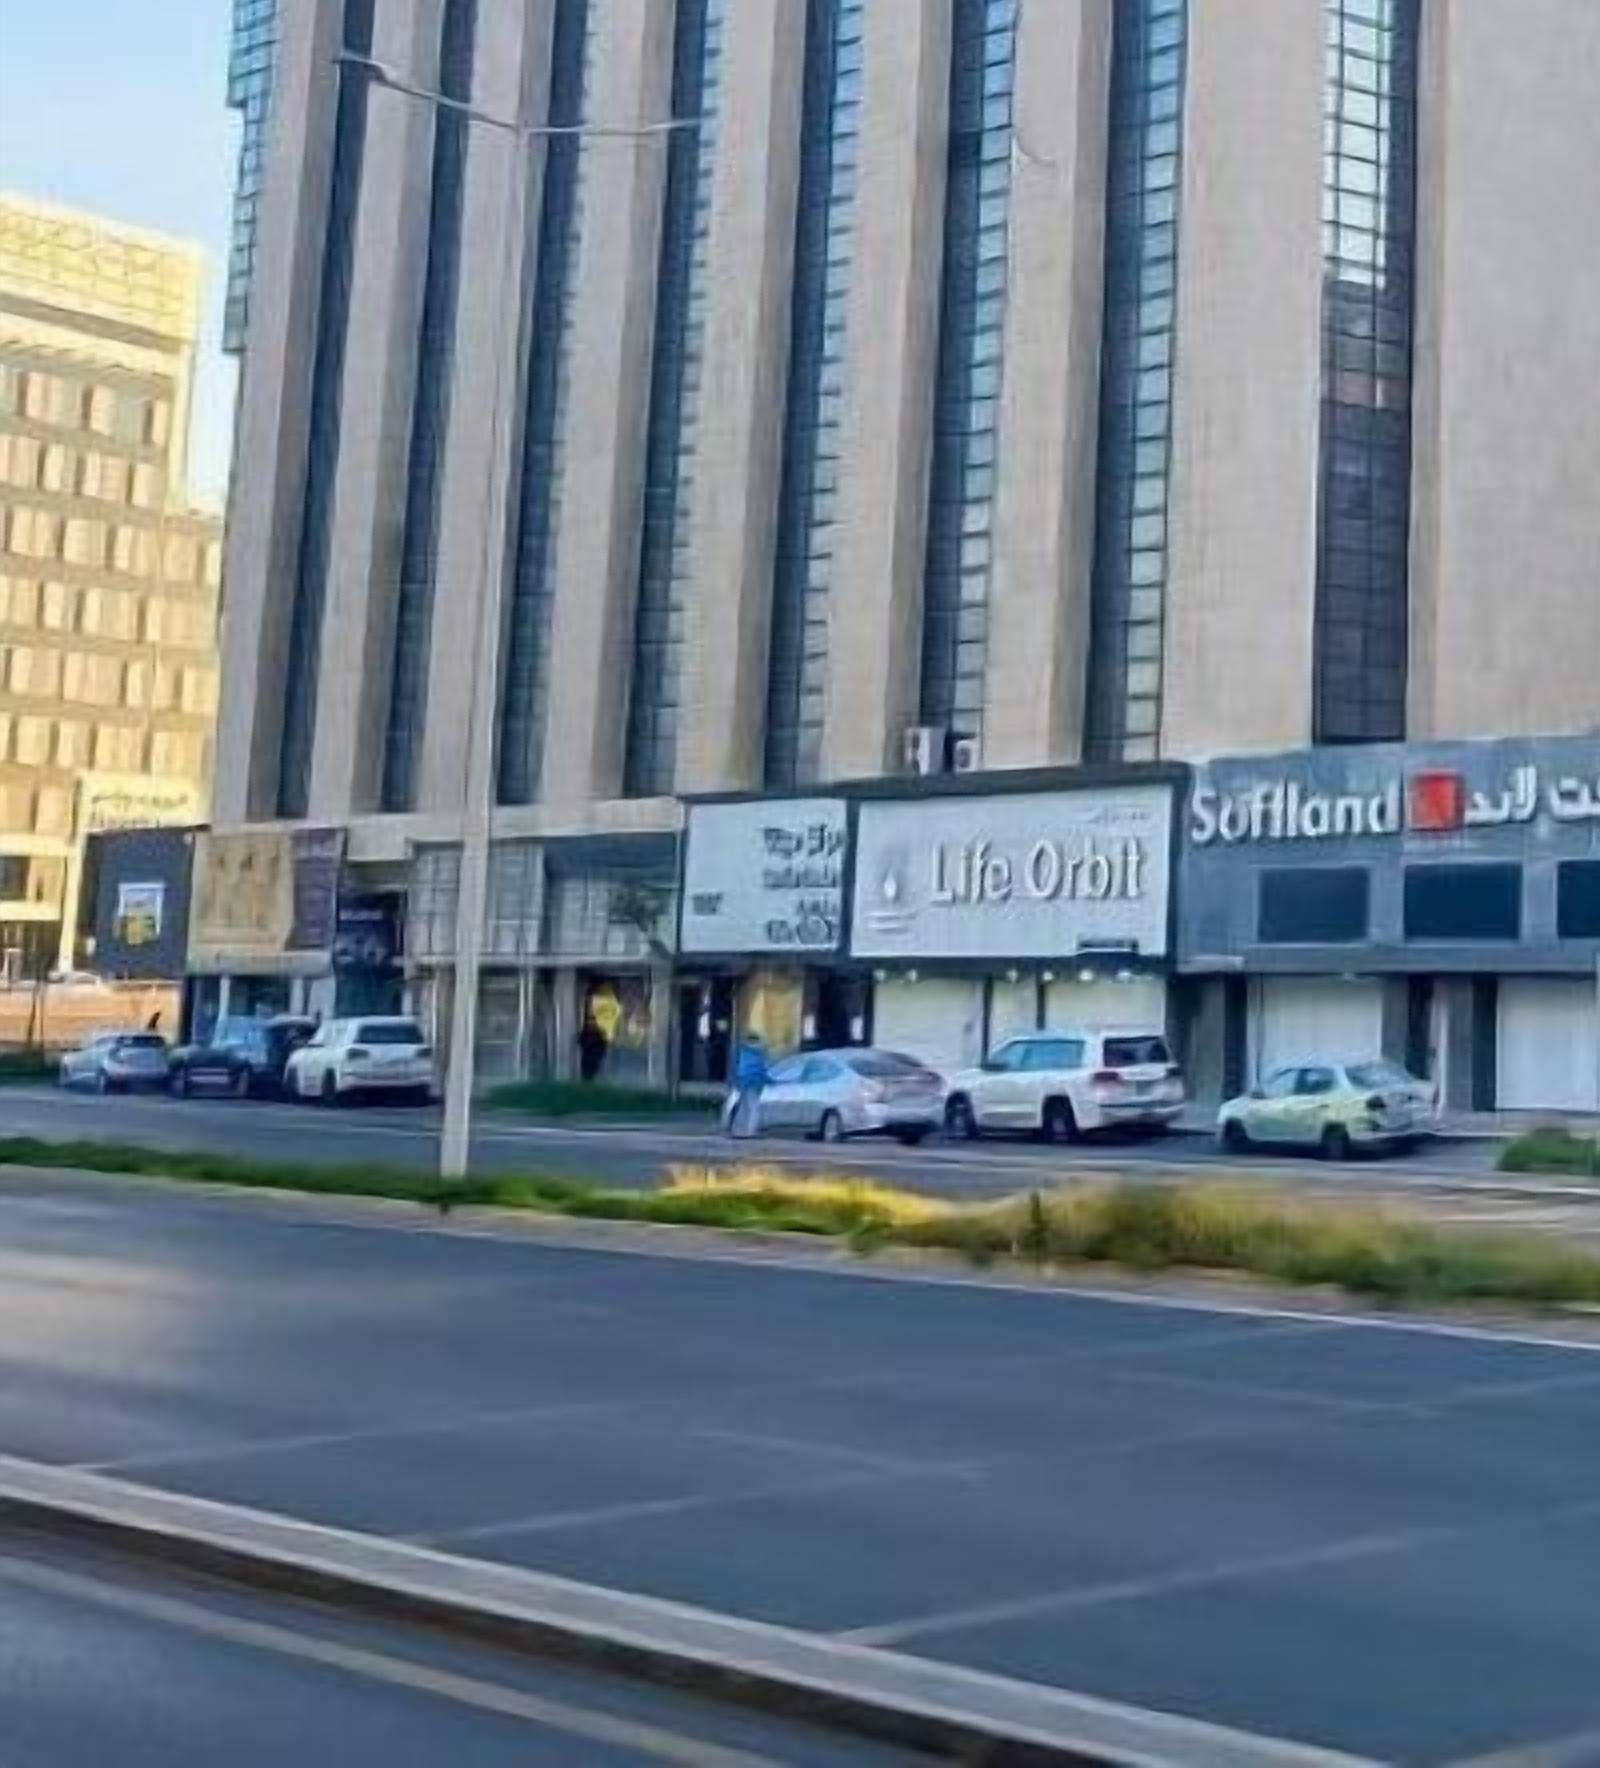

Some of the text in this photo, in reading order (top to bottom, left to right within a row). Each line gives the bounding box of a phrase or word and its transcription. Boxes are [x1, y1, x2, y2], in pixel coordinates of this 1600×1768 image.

[1191, 777, 1400, 843] Softland
[930, 834, 1142, 903] Life Orbit
